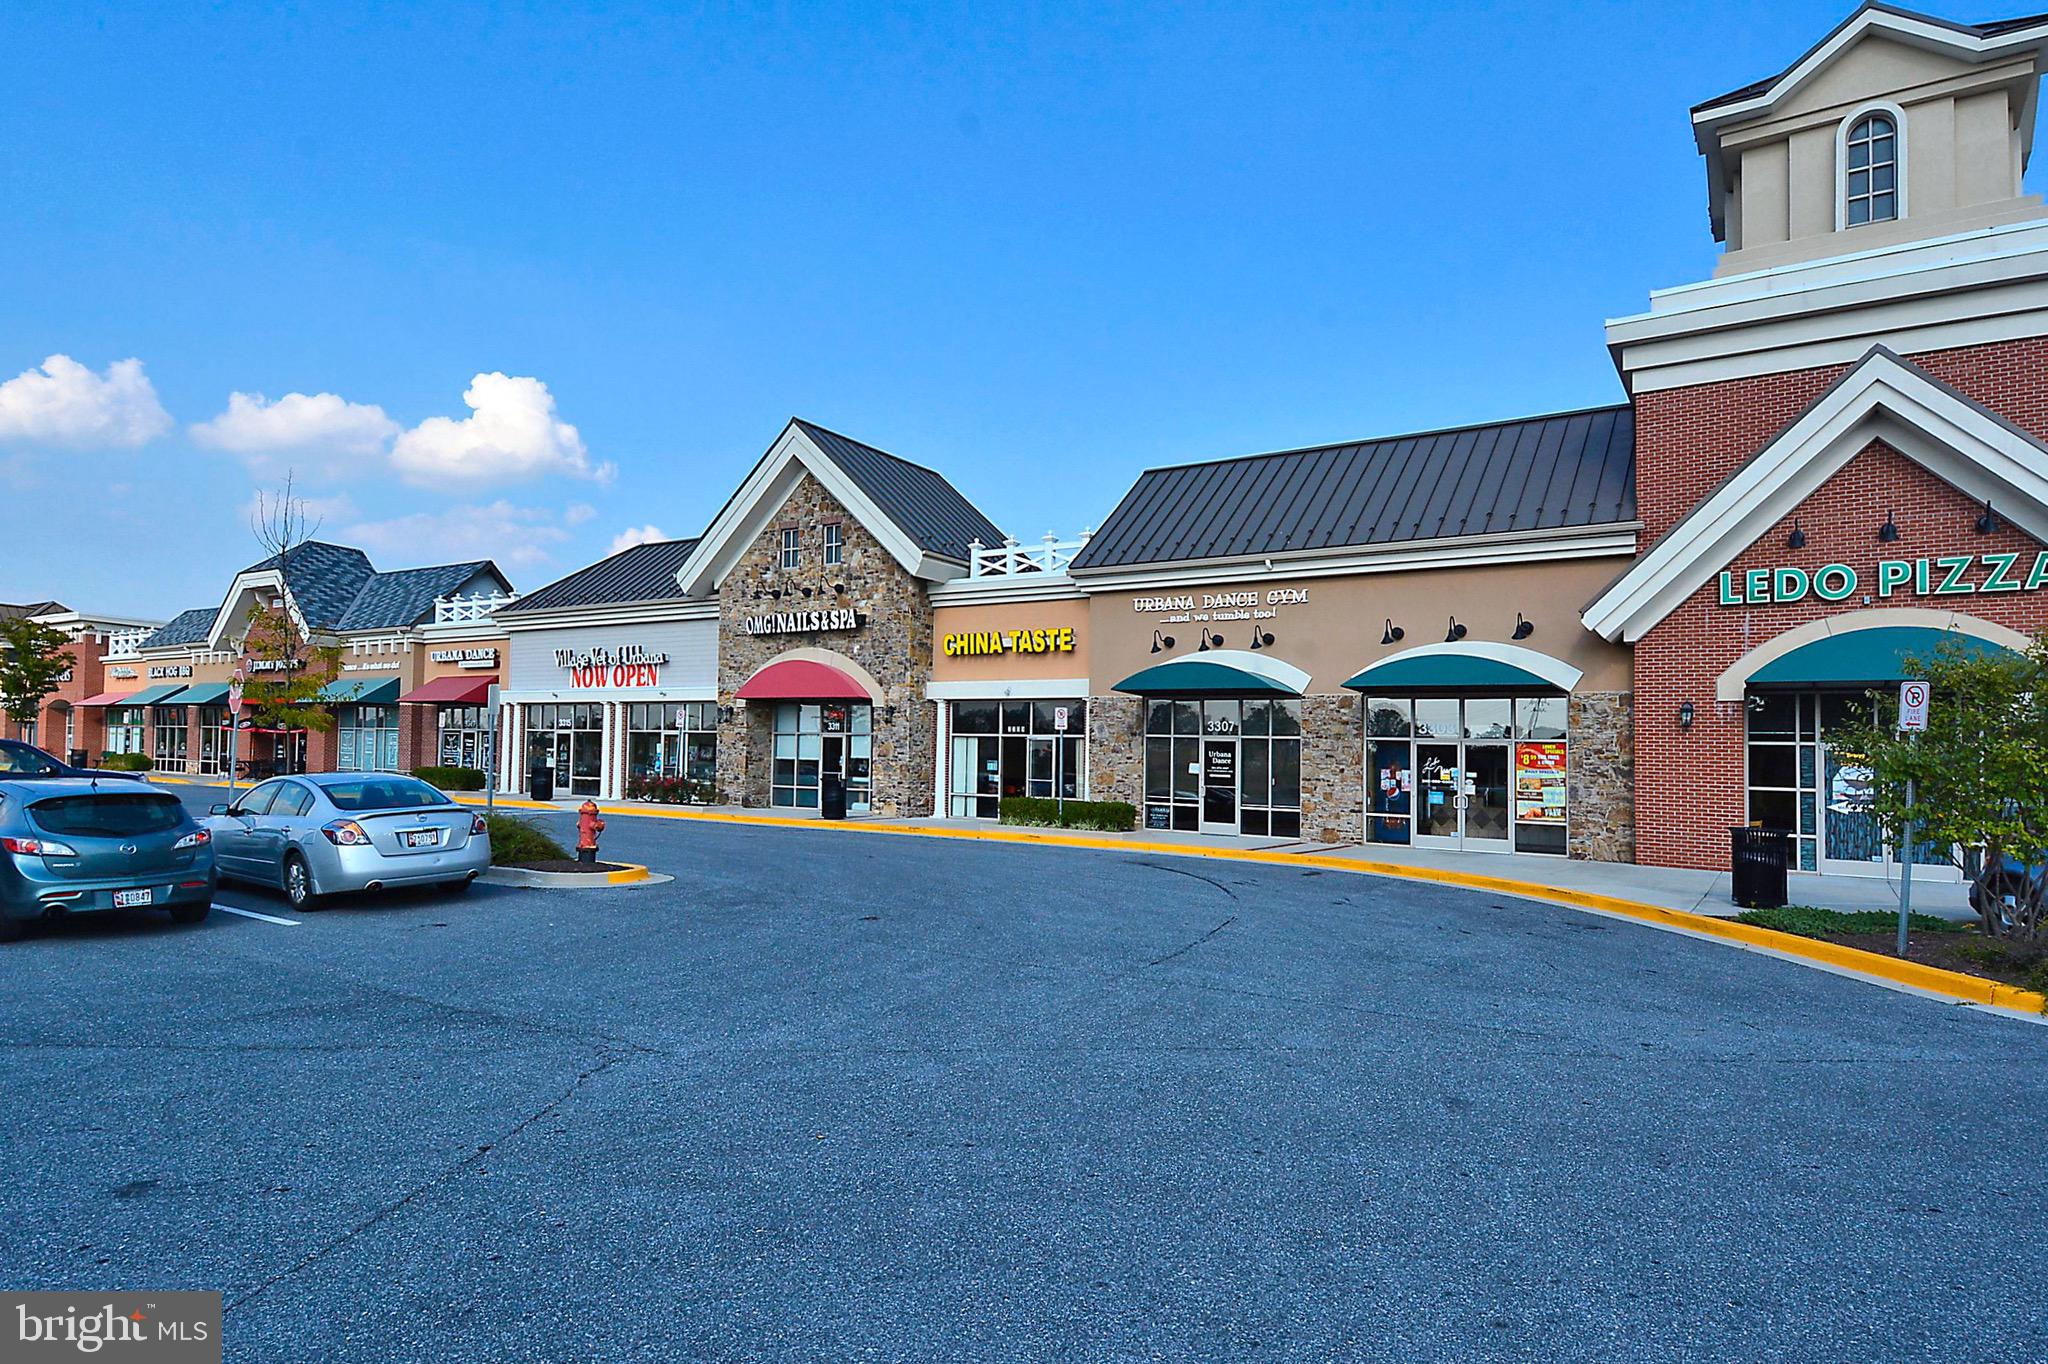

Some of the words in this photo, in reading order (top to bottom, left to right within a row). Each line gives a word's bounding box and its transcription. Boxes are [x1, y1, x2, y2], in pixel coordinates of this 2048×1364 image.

[1719, 563, 1858, 605] LEDO
[1879, 551, 2048, 598] PIZZA
[1133, 596, 1195, 612] URBANA
[1203, 592, 1259, 609] DANCE
[1267, 588, 1309, 606] GYM
[1194, 613, 1209, 622] we
[1212, 609, 1250, 621] tumble
[1253, 607, 1276, 619] too!
[943, 630, 1003, 657] CHINA
[1008, 627, 1074, 653] TASTE
[431, 650, 464, 662] URBANA
[465, 648, 495, 660] DANCE
[553, 648, 589, 669] Village
[592, 646, 607, 666] Vet
[610, 646, 623, 665] of
[625, 644, 665, 664] Urbana
[571, 665, 609, 688] NOW
[613, 664, 658, 688] OPEN
[1207, 721, 1235, 732] 3307
[1208, 750, 1231, 758] Urbana
